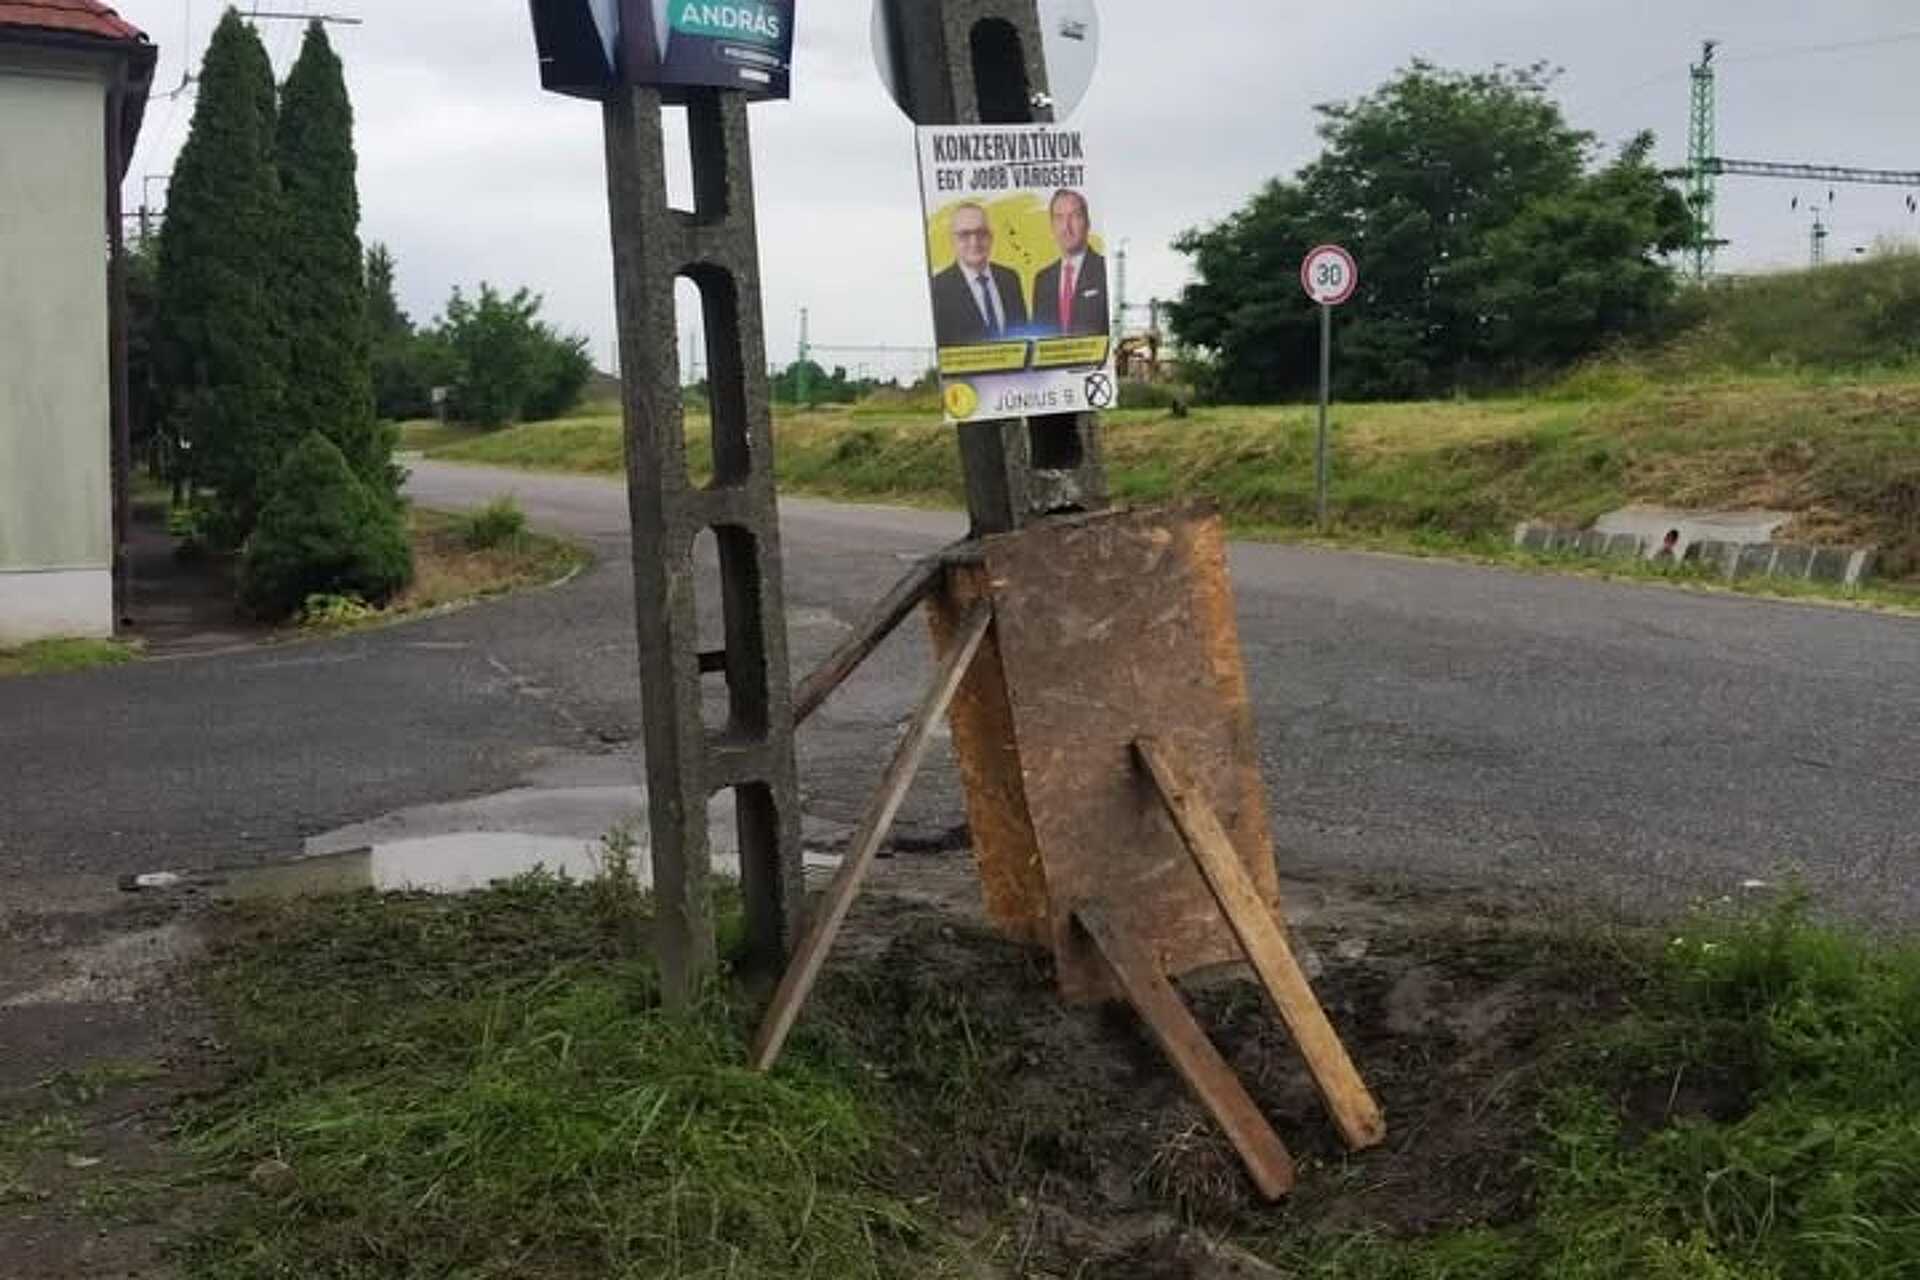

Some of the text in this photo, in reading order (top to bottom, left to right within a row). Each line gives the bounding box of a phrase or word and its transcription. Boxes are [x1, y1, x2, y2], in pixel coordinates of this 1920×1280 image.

[682, 2, 780, 38] ANDRÁS
[932, 127, 1083, 162] KONZERVATÍVOK
[936, 168, 963, 190] EGY
[970, 165, 1009, 190] JOBB
[1316, 263, 1342, 286] 30
